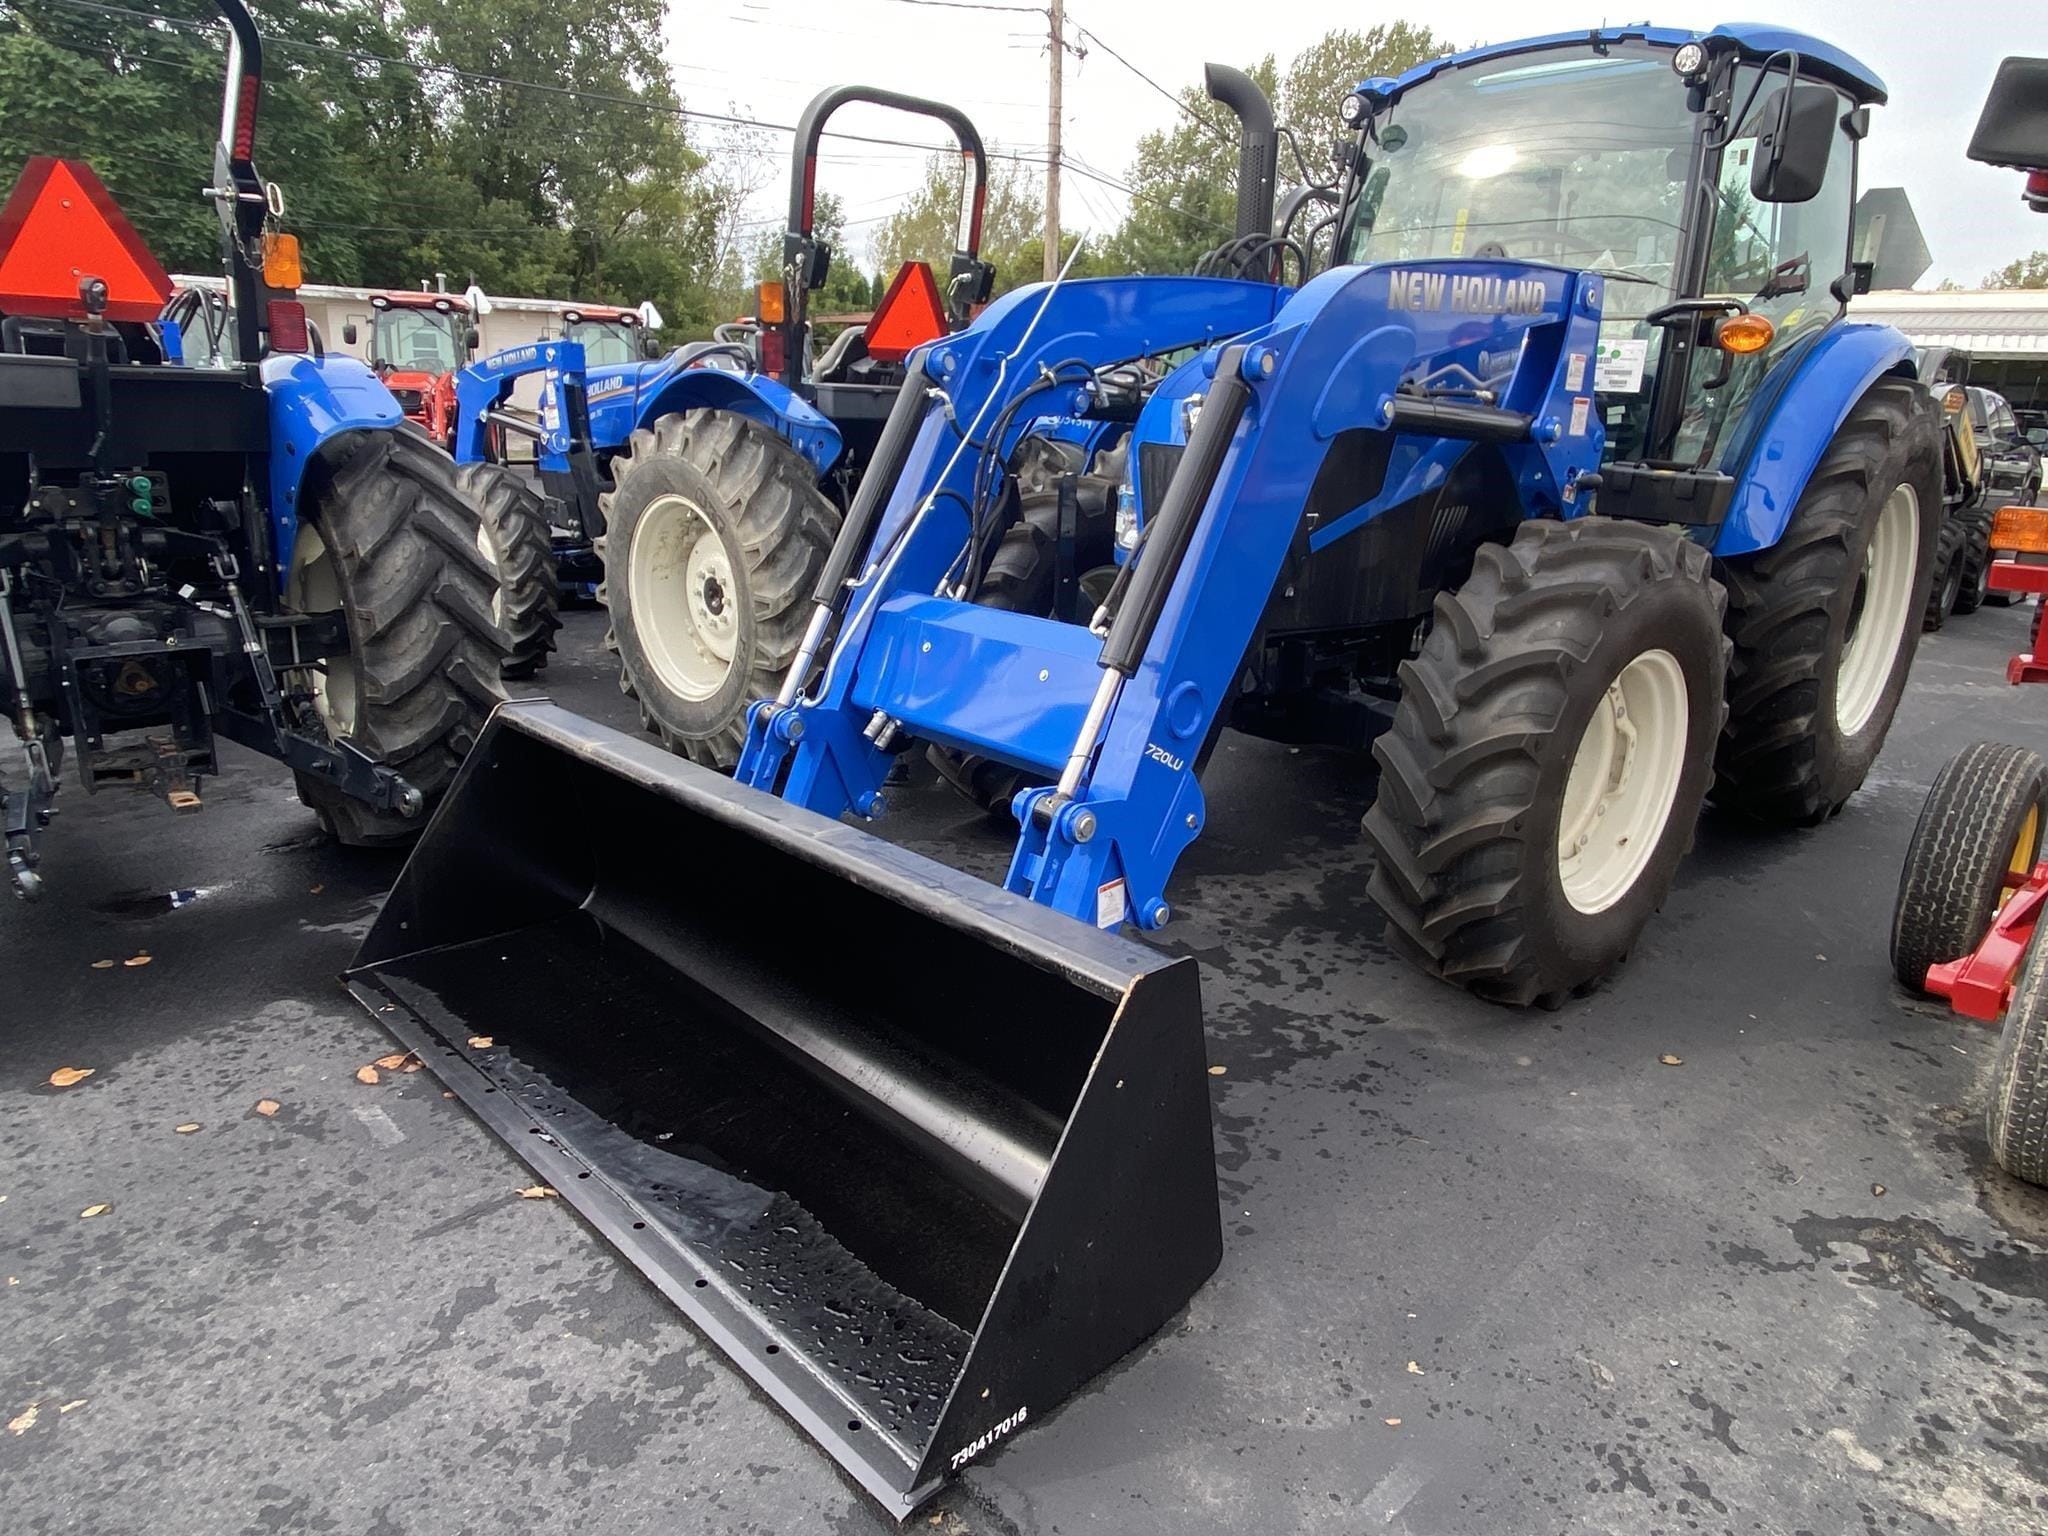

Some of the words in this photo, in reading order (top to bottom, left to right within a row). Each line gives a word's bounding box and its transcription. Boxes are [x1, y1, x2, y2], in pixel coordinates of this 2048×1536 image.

[1388, 270, 1446, 312] NEW
[1453, 275, 1546, 315] HOLLAND
[486, 355, 502, 370] NEW
[503, 347, 537, 365] HOLLAND
[1145, 743, 1184, 771] 720LU
[951, 1406, 1027, 1469] 730417016
